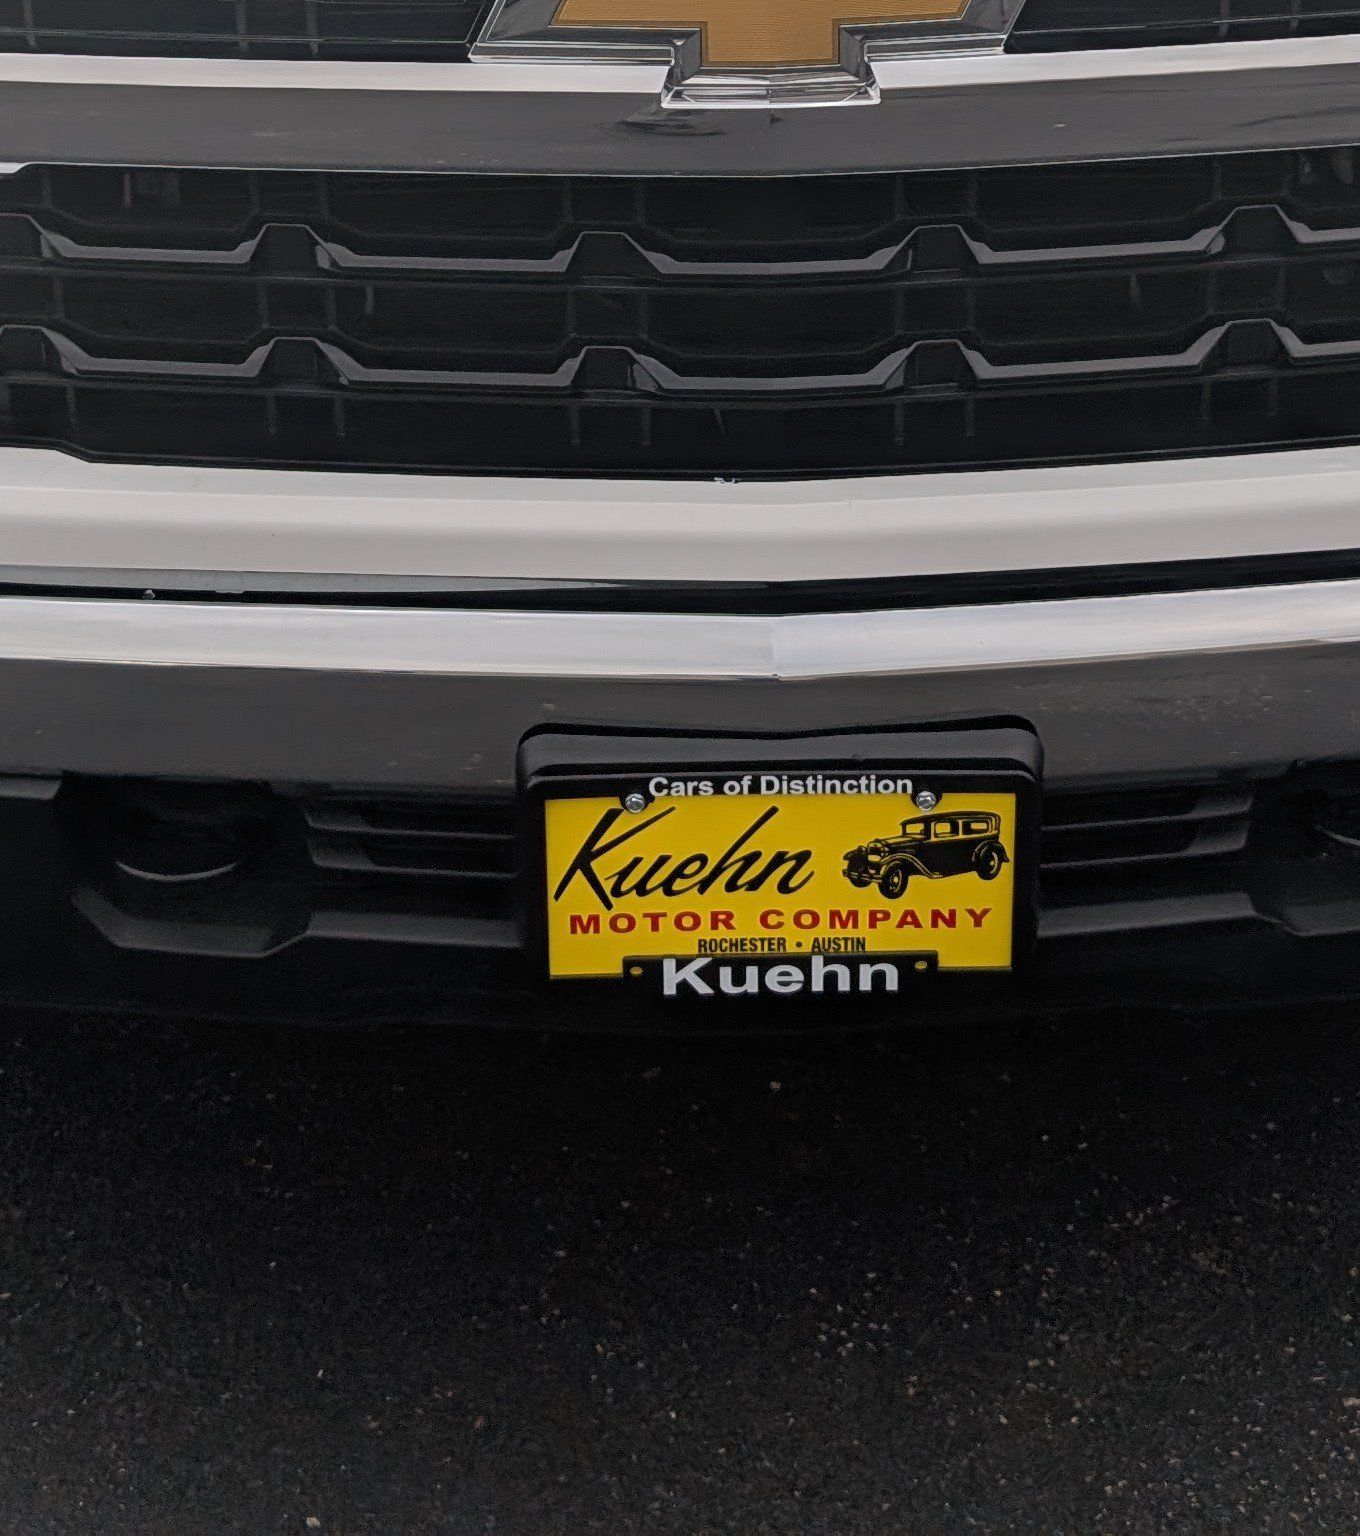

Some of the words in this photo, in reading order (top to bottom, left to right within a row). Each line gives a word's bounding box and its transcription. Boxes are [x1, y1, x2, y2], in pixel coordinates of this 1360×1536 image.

[648, 776, 715, 797] Cars
[723, 775, 753, 796] of
[760, 773, 913, 796] Distinction
[553, 805, 815, 911] Kuehn
[569, 910, 736, 935] MOTOR
[759, 907, 992, 930] COMPANY
[697, 937, 787, 953] ROCHESTER
[811, 936, 867, 952] AUSTIN
[663, 956, 899, 996] Kuehn
